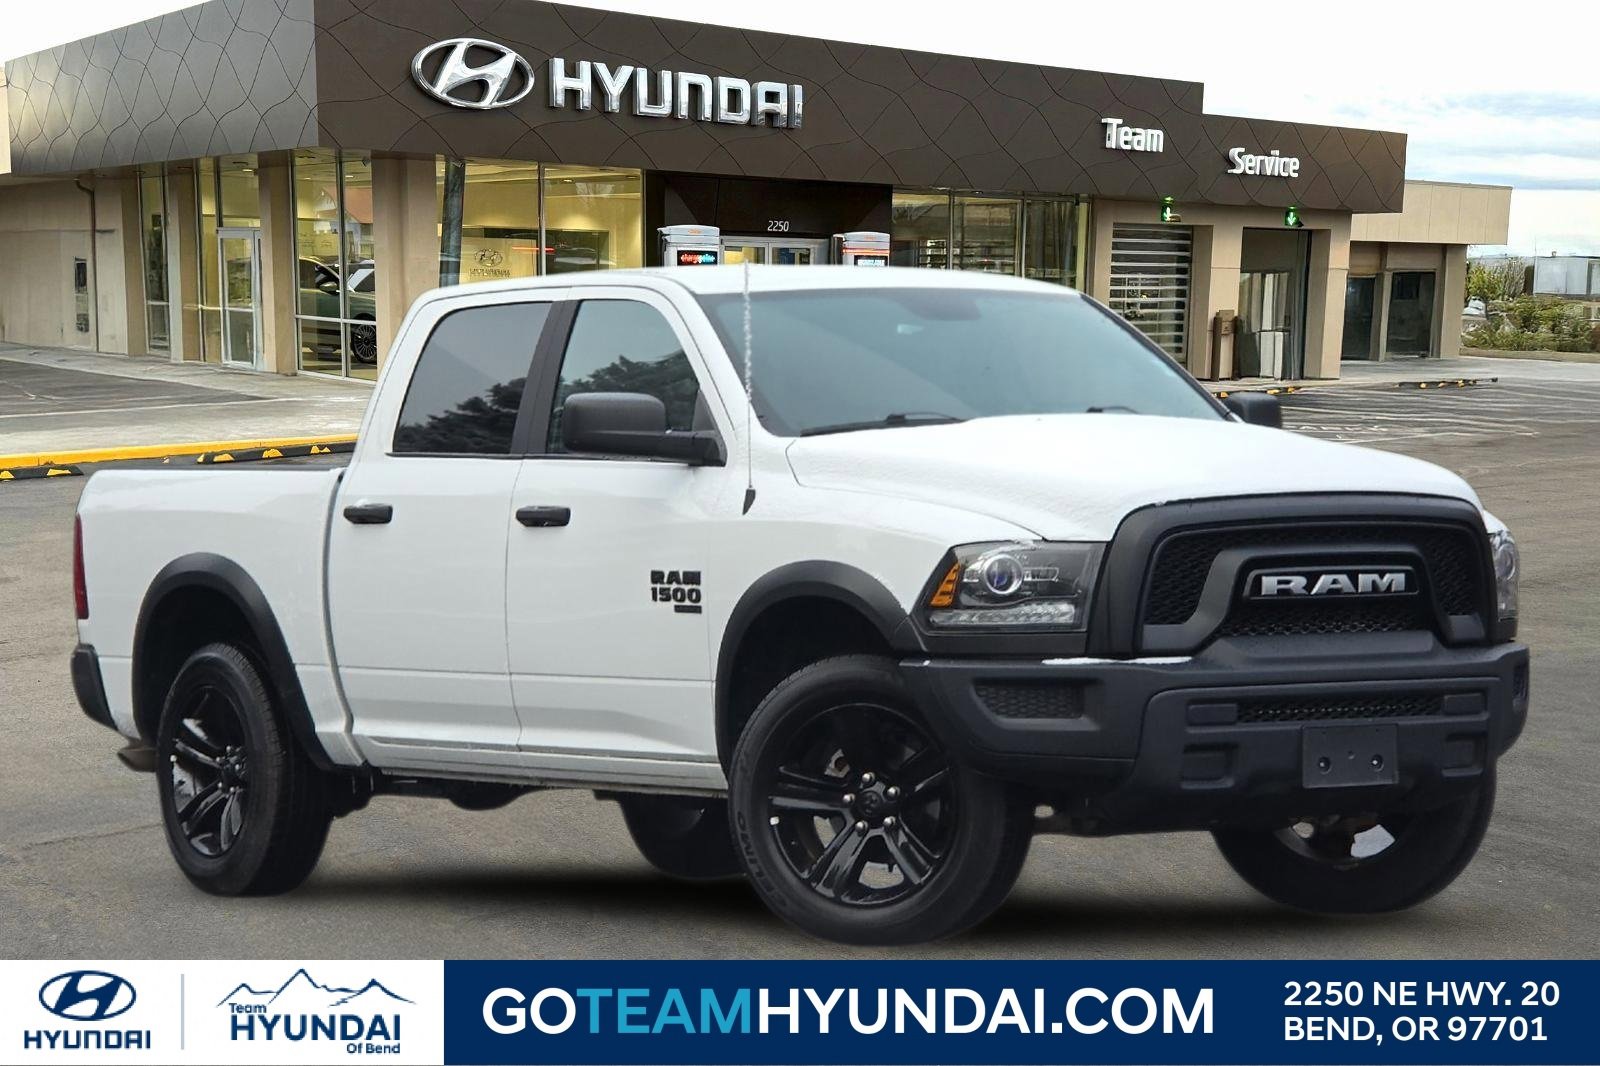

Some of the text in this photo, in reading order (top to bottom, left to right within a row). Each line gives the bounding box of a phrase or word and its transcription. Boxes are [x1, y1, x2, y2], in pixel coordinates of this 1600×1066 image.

[549, 57, 803, 129] HYUNDAI
[1101, 117, 1164, 152] Team
[1227, 147, 1300, 178] Service
[767, 220, 790, 232] 2250
[650, 569, 702, 586] RAM
[1261, 572, 1406, 596] RAM
[650, 586, 702, 604] 1500
